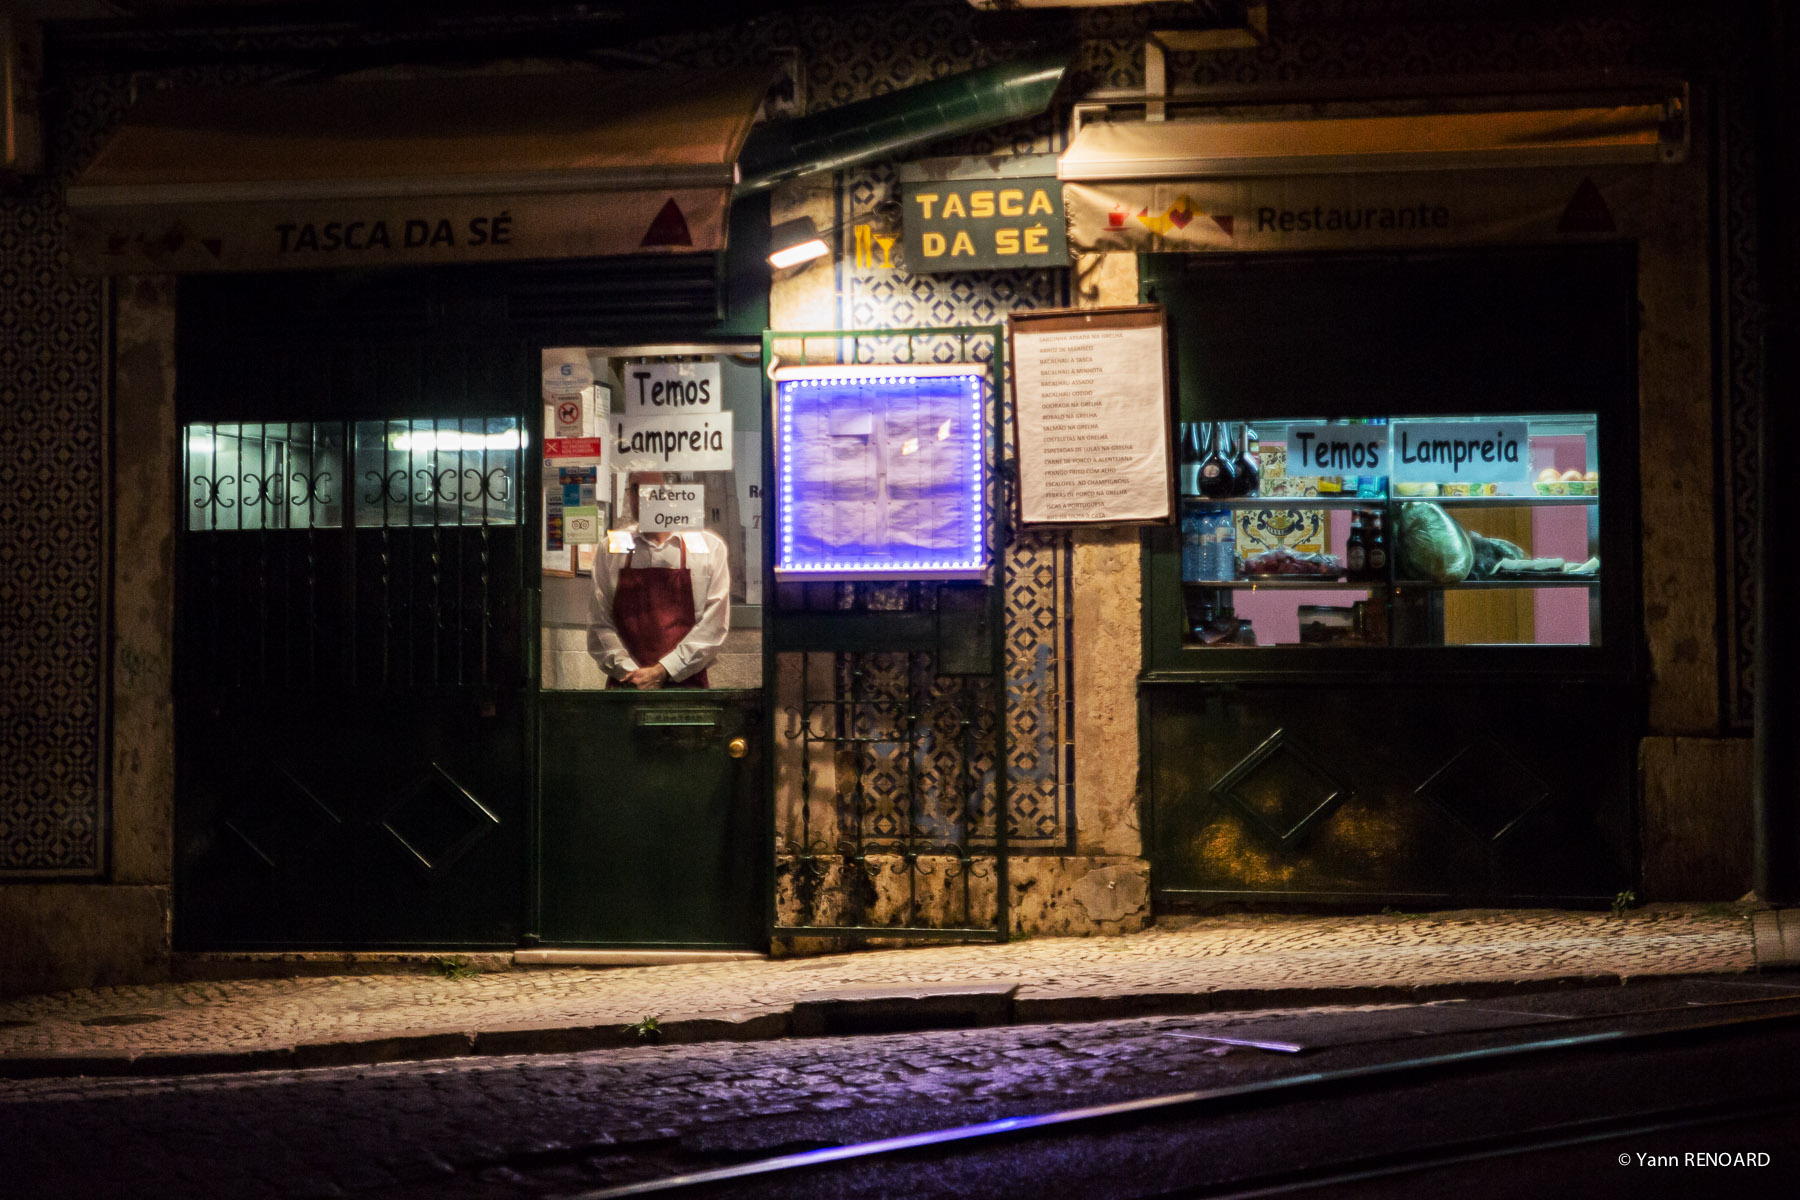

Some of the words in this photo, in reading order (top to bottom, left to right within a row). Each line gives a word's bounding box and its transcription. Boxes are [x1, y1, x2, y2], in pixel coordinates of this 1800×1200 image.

[915, 189, 1053, 219] TASCA
[1257, 202, 1450, 232] Restaurante
[275, 220, 391, 252] TASCA
[403, 219, 455, 248] DA
[467, 211, 513, 246] SÉ
[922, 230, 976, 257] DA
[995, 222, 1049, 254] SÉ
[633, 372, 710, 407] Temos
[618, 422, 723, 462] Lampreia
[1296, 432, 1379, 470] Temos
[1401, 431, 1518, 473] Lampreia
[649, 489, 695, 501] Aberto
[655, 513, 689, 527] Open
